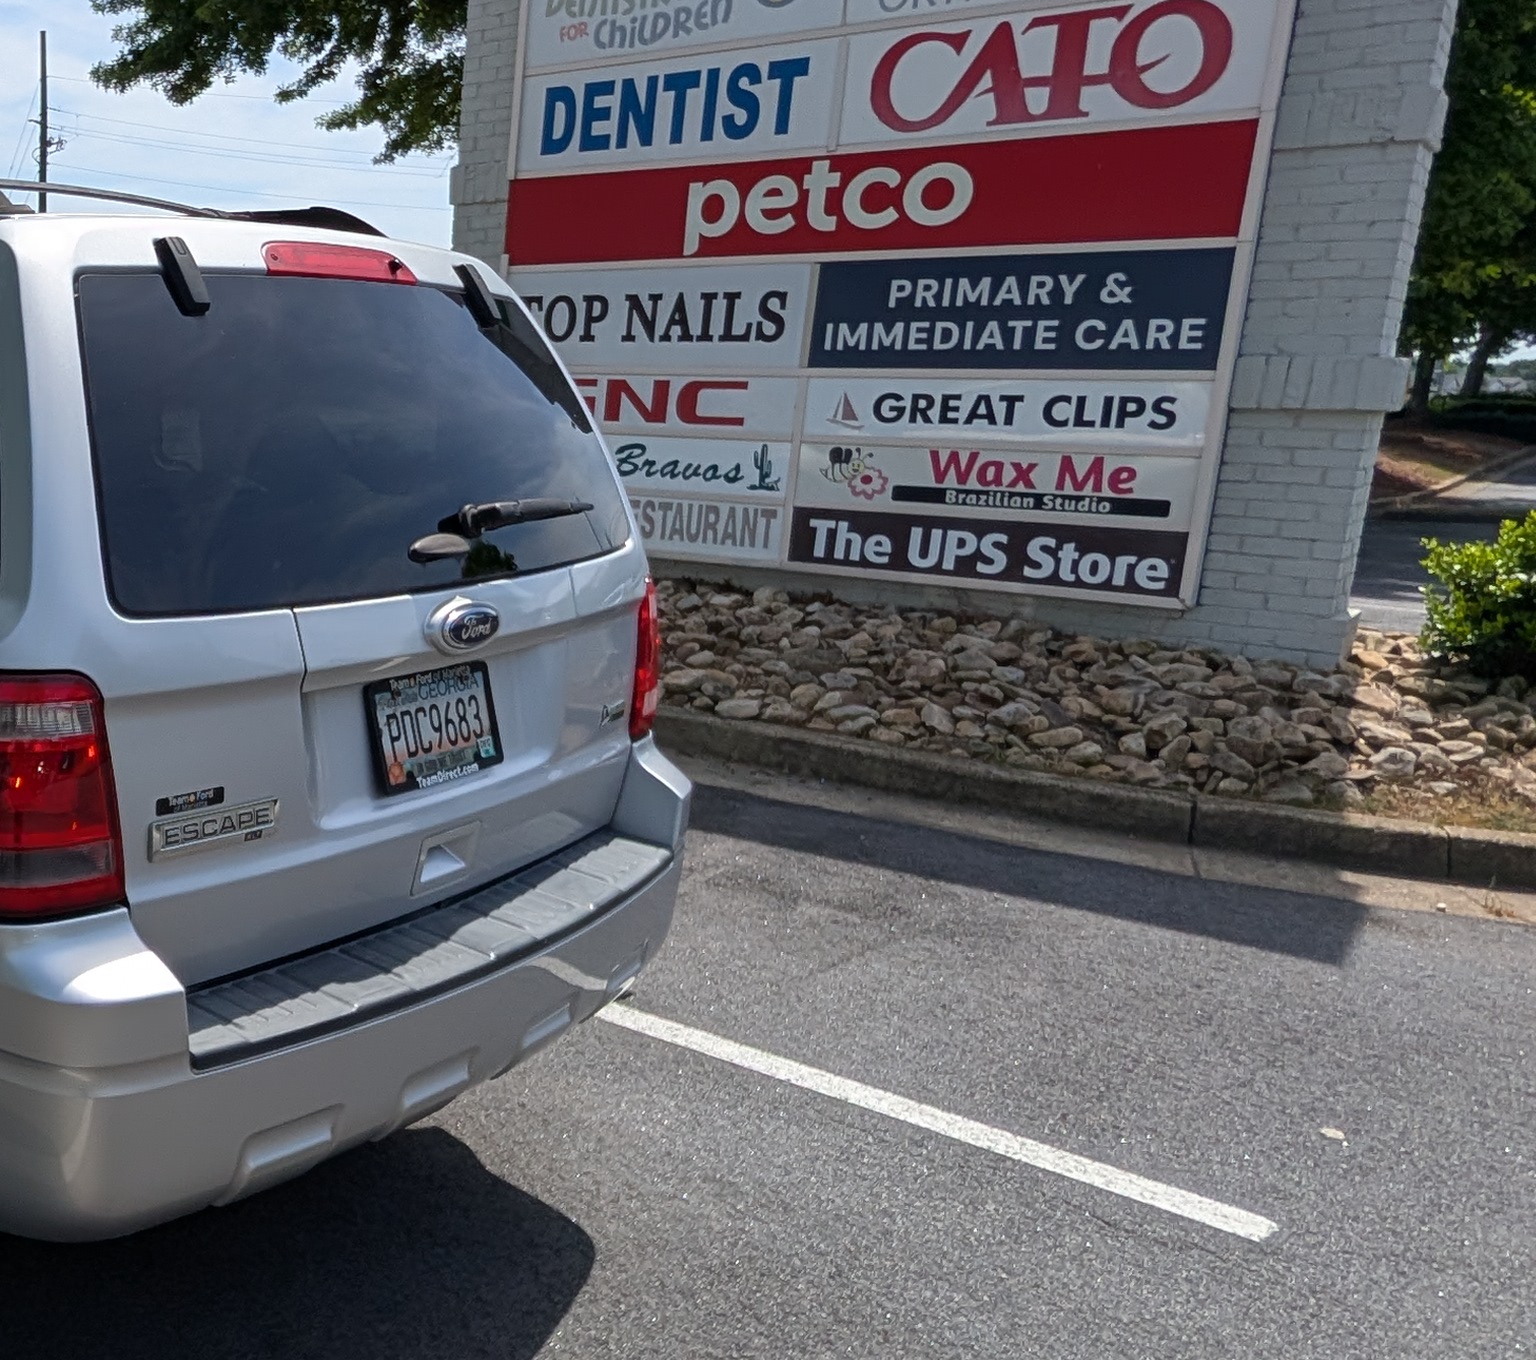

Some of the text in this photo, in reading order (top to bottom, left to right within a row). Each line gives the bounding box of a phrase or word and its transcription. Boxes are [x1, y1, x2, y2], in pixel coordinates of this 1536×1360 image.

[560, 21, 589, 42] FOR
[540, 56, 810, 155] DENTIST
[683, 160, 974, 256] petco
[888, 272, 1133, 308] PRIMARY &
[621, 290, 789, 343] NAILS
[823, 317, 1207, 351] IMMEDIATE CARE
[872, 392, 1178, 431] GREAT CLIPS
[614, 443, 745, 484] Bravos
[929, 449, 1138, 496] Wax Me
[945, 488, 1111, 514] Brazilian Studio
[809, 518, 1170, 591] The UPS Store
[461, 614, 492, 640] Ford
[418, 673, 480, 700] GEORGIA
[386, 694, 485, 762] PDC9683
[165, 807, 270, 845] ESCAPE
